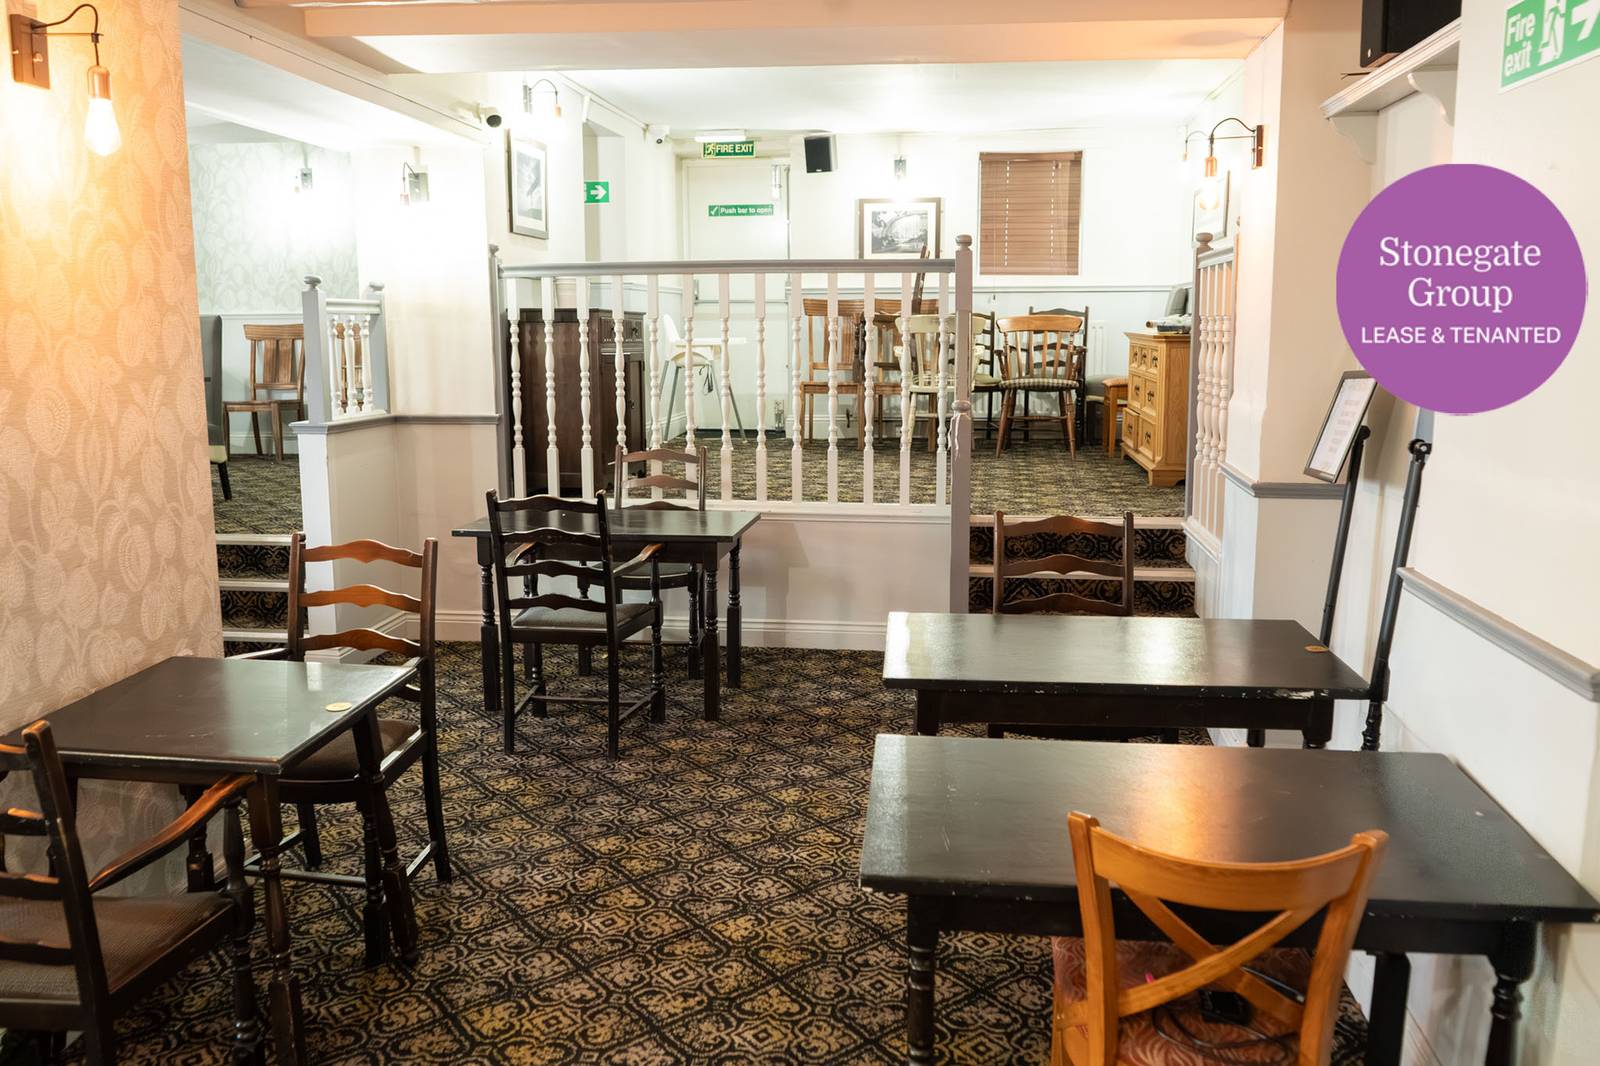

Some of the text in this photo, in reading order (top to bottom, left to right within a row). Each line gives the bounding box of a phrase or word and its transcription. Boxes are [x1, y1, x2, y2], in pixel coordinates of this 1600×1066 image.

[1506, 13, 1536, 47] Fire
[1505, 40, 1532, 77] exit
[716, 143, 753, 153] FIRE EXIT
[757, 207, 773, 216] open
